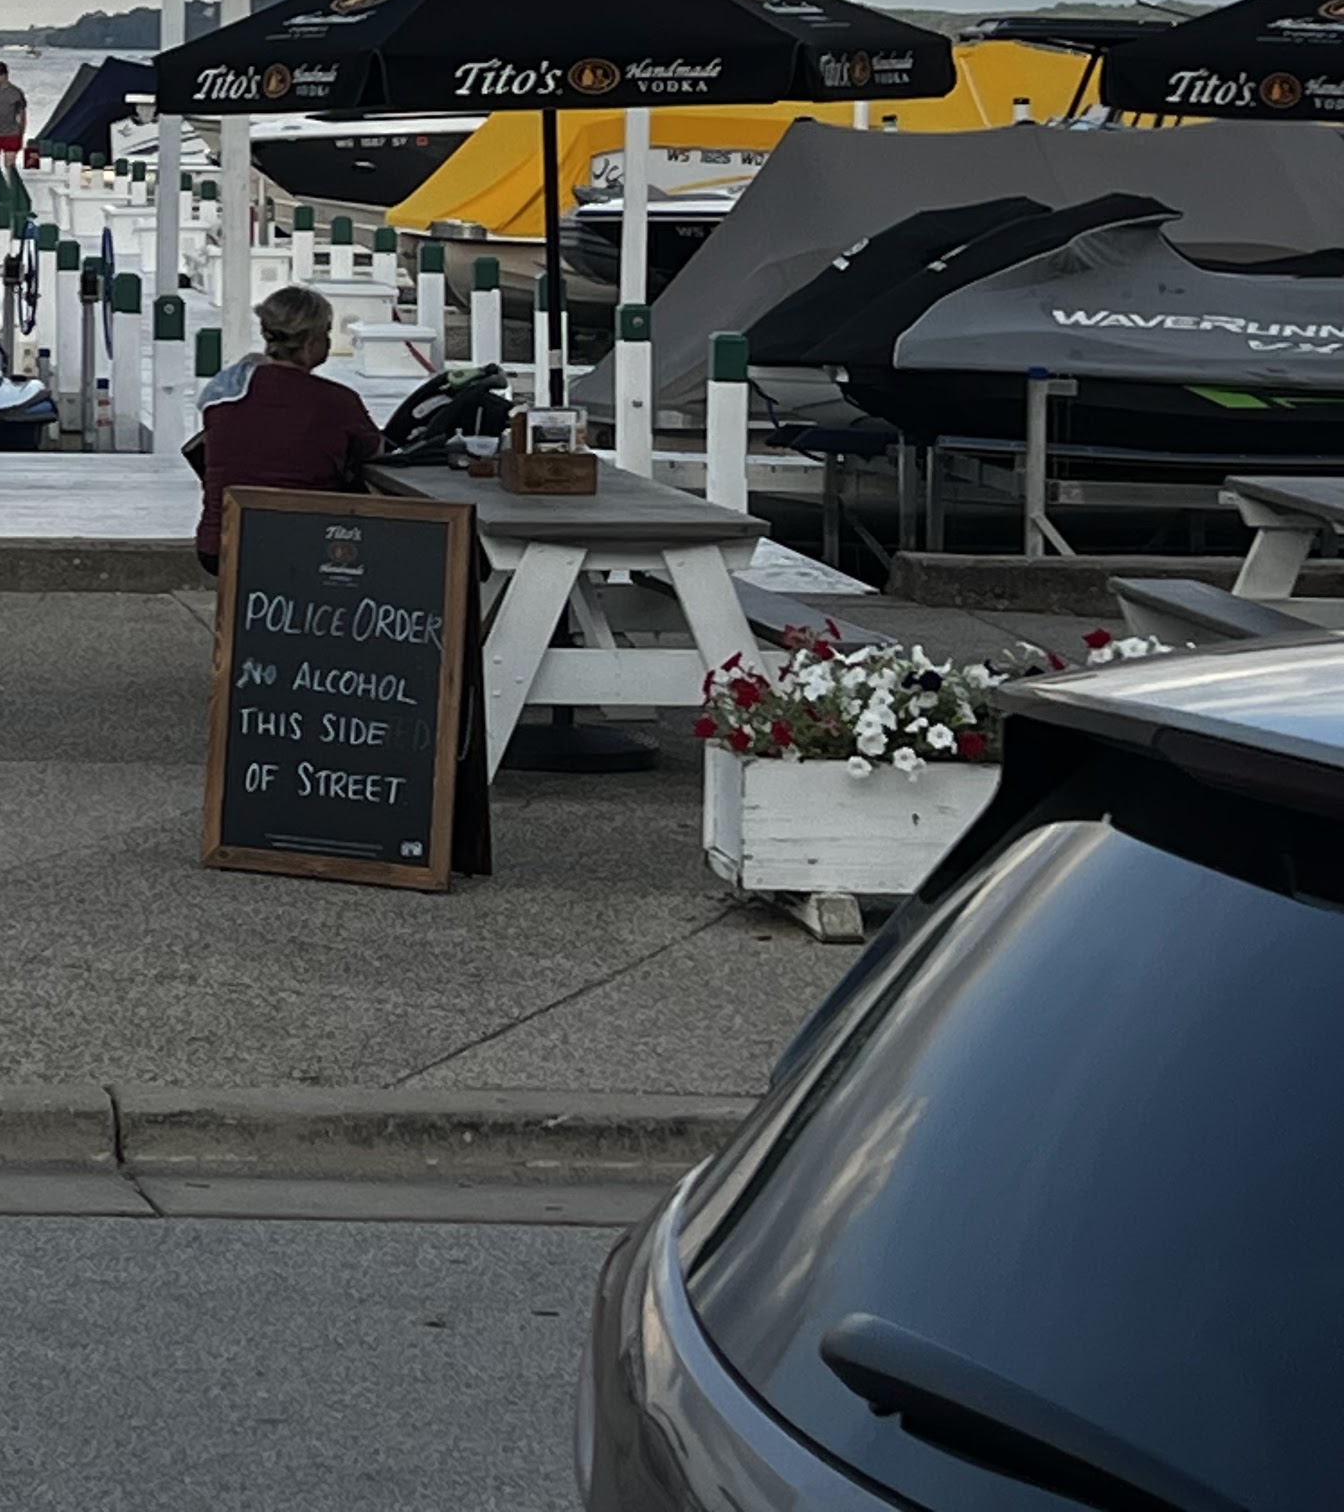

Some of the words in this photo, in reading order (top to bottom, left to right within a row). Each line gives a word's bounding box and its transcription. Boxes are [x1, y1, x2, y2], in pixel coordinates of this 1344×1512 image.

[192, 64, 261, 100] Tito's
[454, 58, 563, 95] Tito's
[625, 58, 723, 79] Handmade
[637, 80, 709, 93] VODKA
[1165, 67, 1257, 107] Tito's
[666, 149, 690, 163] WS
[245, 591, 347, 637] POLICE
[352, 597, 444, 651] ORDER
[236, 657, 278, 688] NO
[292, 661, 418, 705] ALCOHOL
[239, 707, 303, 741] THIS
[320, 713, 389, 745] SIDE
[245, 762, 280, 792] OF
[297, 761, 407, 805] STREET
